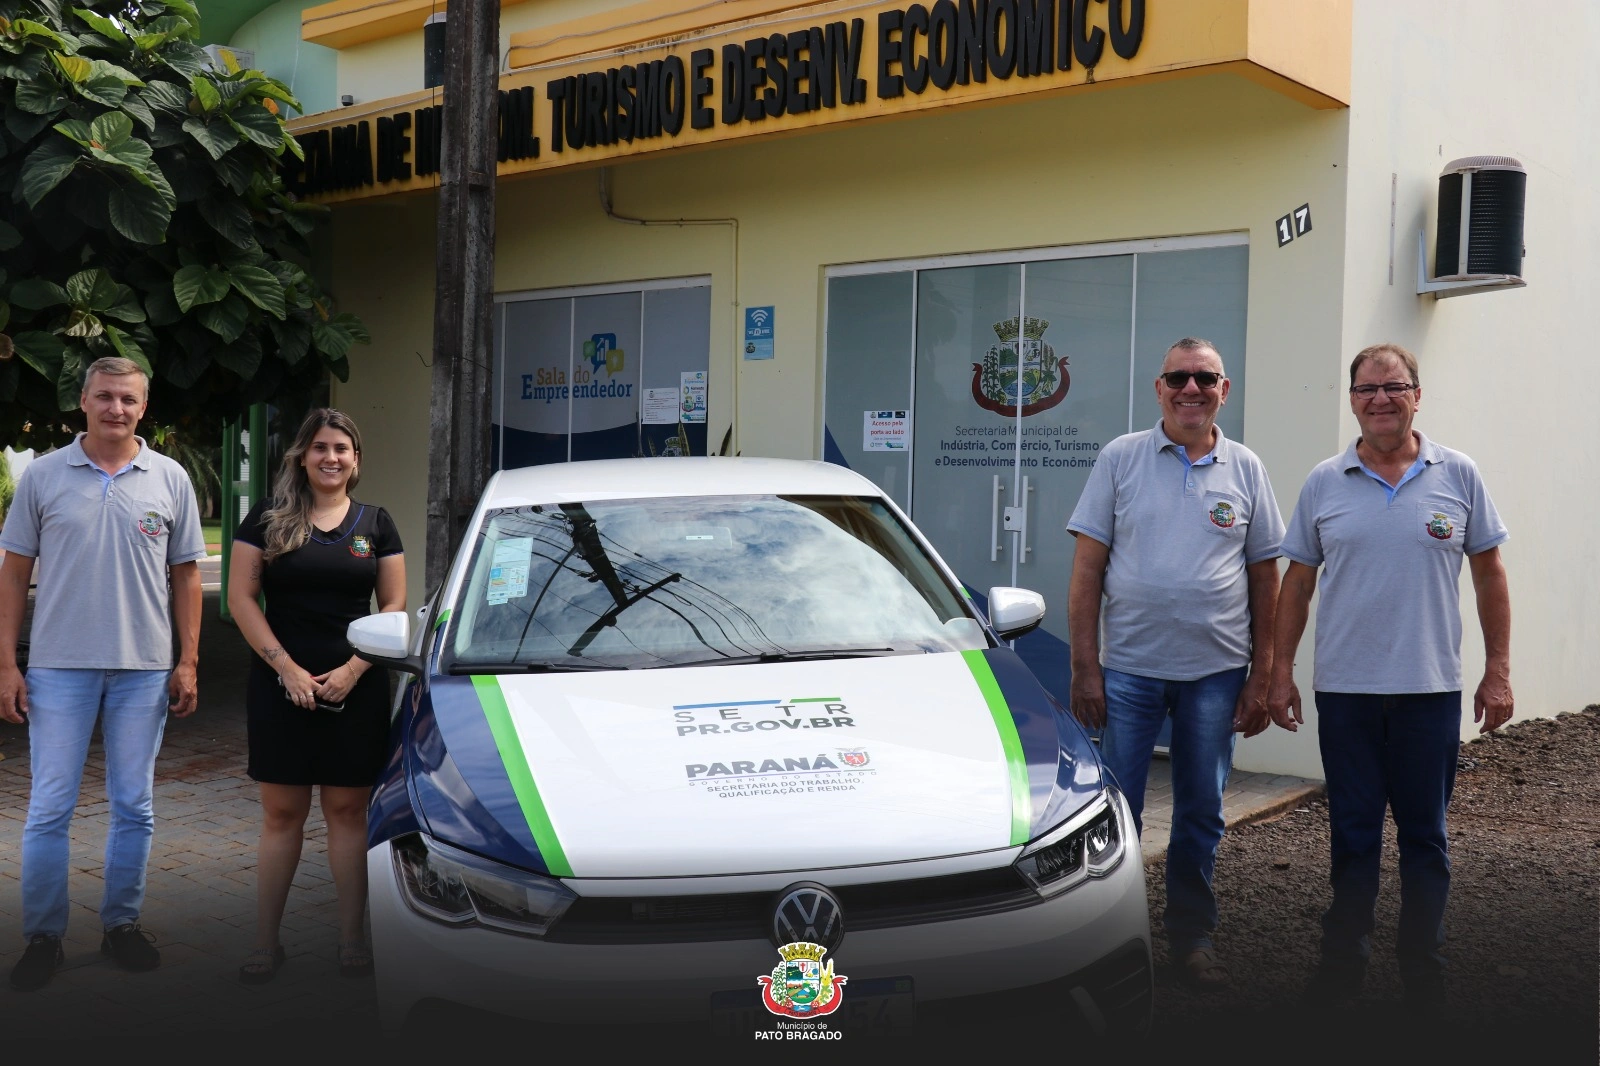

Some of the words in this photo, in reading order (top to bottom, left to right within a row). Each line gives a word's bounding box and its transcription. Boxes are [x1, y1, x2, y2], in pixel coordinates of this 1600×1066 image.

[546, 55, 685, 152] TURISMO
[690, 48, 714, 131] E
[721, 18, 867, 126] DESENV.
[377, 112, 413, 184] DE
[1279, 207, 1308, 243] 17
[536, 367, 566, 386] Sala
[573, 365, 590, 384] do
[521, 374, 633, 404] Empreendedor
[892, 420, 904, 428] pela
[955, 425, 1007, 437] Secretaria
[1008, 425, 1062, 440] Municipal
[1064, 425, 1078, 437] de
[940, 439, 988, 452] Indústria,
[991, 439, 1051, 453] Comércio,
[1055, 439, 1100, 452] Turismo
[935, 457, 942, 467] e
[943, 456, 1038, 468] Desenvolvimento
[1042, 455, 1098, 468] Econômic
[676, 716, 857, 735] PR.GOV.BR
[685, 754, 839, 779] PARANÁ
[689, 776, 768, 787] GOVERNO
[814, 771, 878, 780] ESTADO
[707, 781, 779, 793] SECRETARIA
[780, 780, 797, 788] DO
[799, 778, 865, 788] TRABALHO,
[718, 786, 804, 799] QUALIFICAÇÃO
[806, 785, 815, 793] E
[817, 784, 856, 792] RENDA
